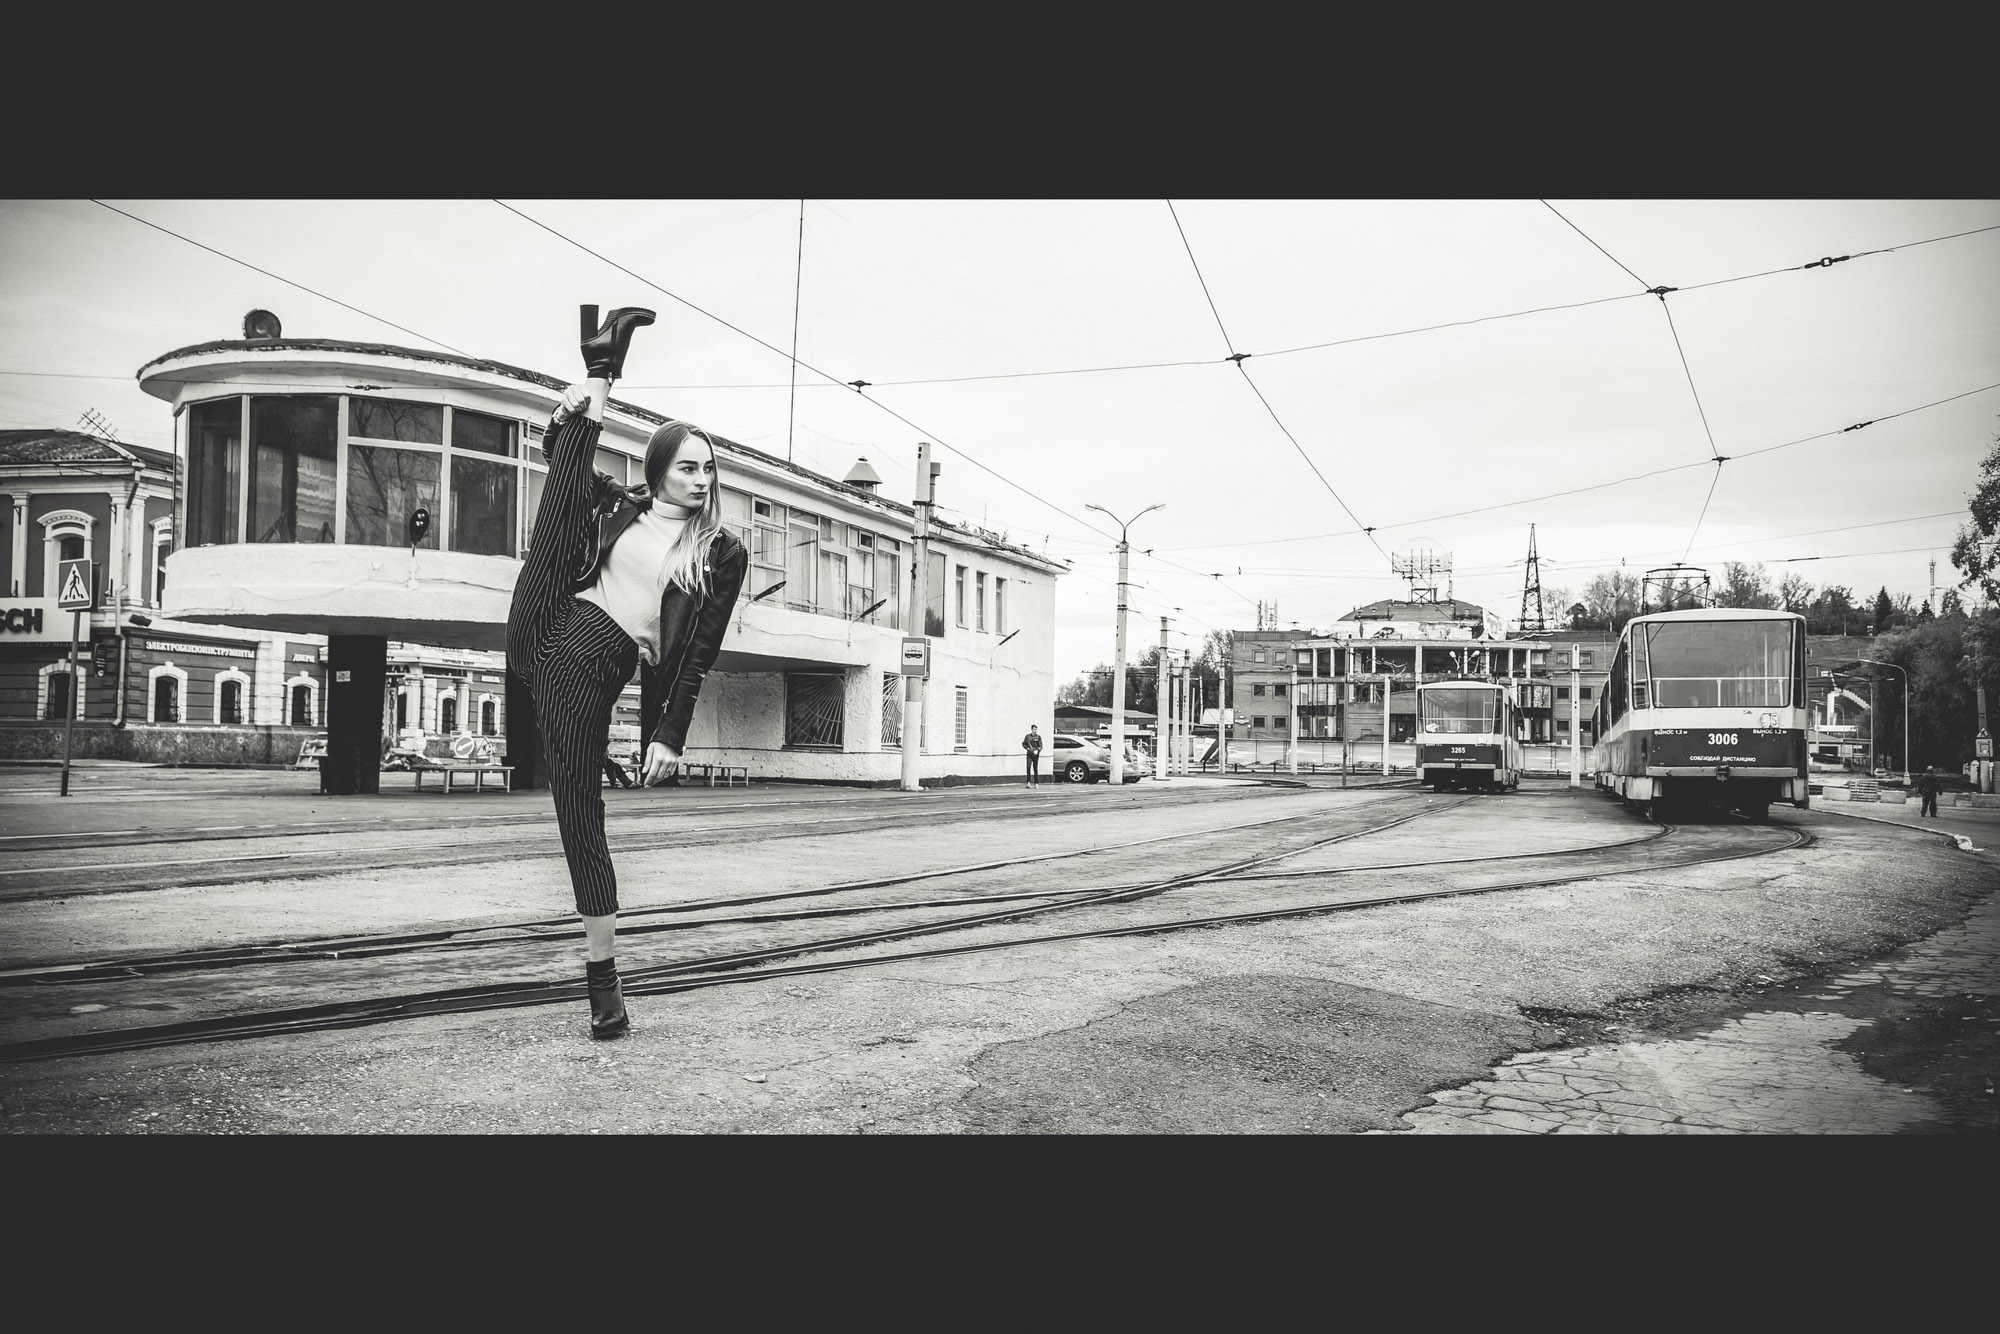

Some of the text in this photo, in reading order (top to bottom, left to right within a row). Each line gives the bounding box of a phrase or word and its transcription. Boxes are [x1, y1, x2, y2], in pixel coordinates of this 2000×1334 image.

[146, 641, 255, 659] ЭЛЕКТРОБЕНЗОИНСТРУМЕНТЫ
[292, 653, 316, 663] ДВЕРИ
[1707, 733, 1738, 745] 3006
[1450, 746, 1466, 754] 3265
